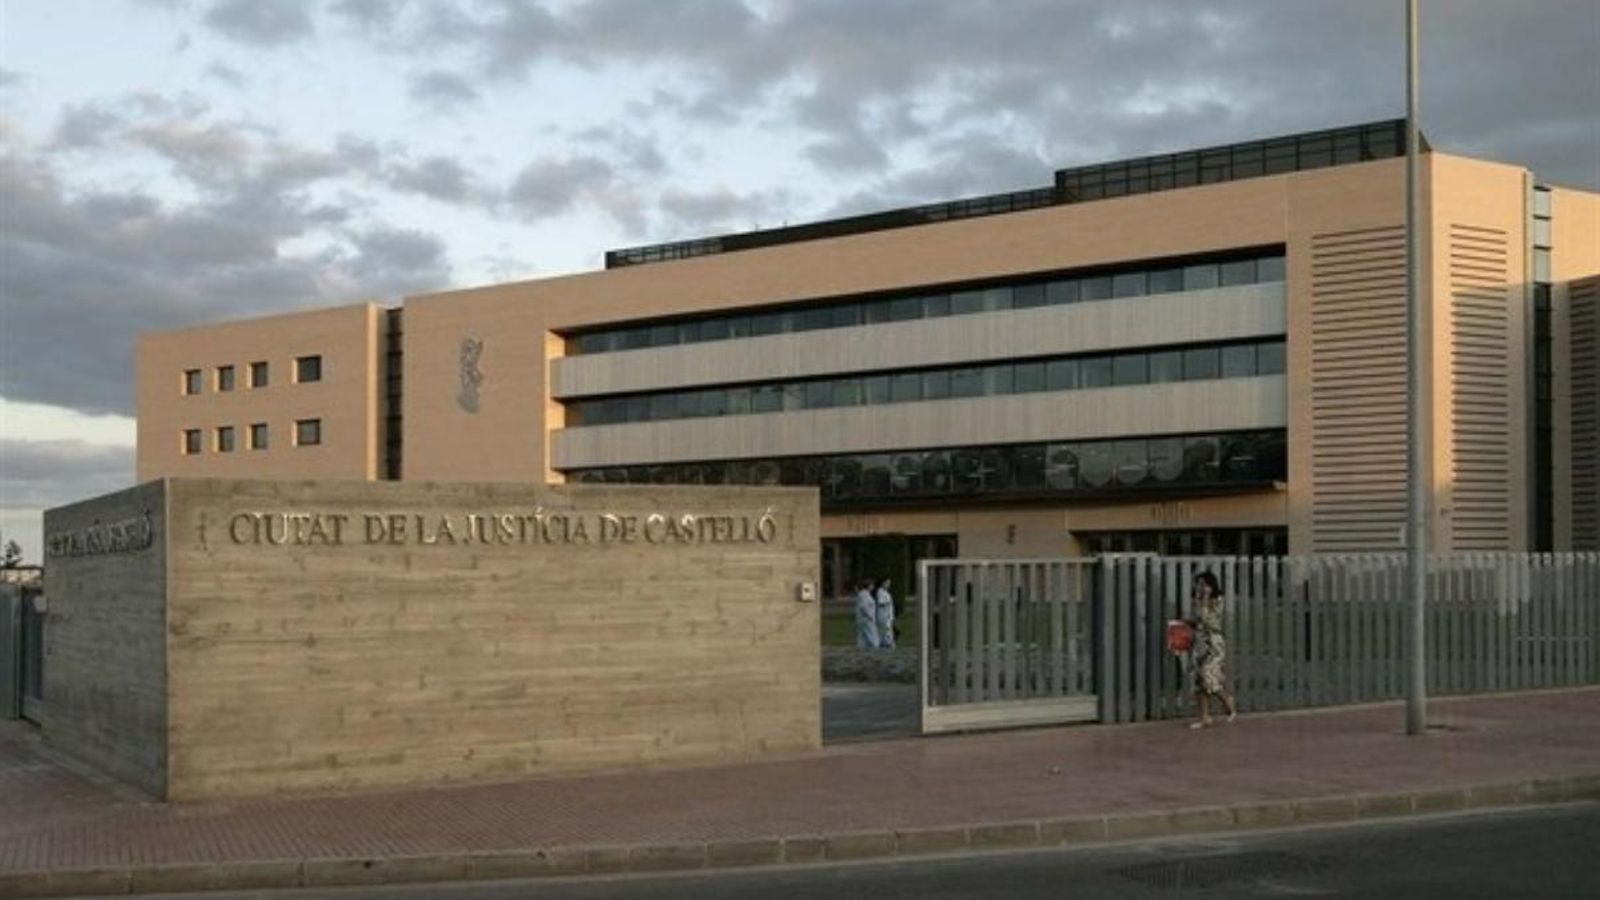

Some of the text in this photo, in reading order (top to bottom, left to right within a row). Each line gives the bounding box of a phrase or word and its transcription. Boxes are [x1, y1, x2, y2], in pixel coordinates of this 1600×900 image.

[229, 505, 777, 545] CIUTAT DE LA JUSTÍCIA DE CASTELLÓ
